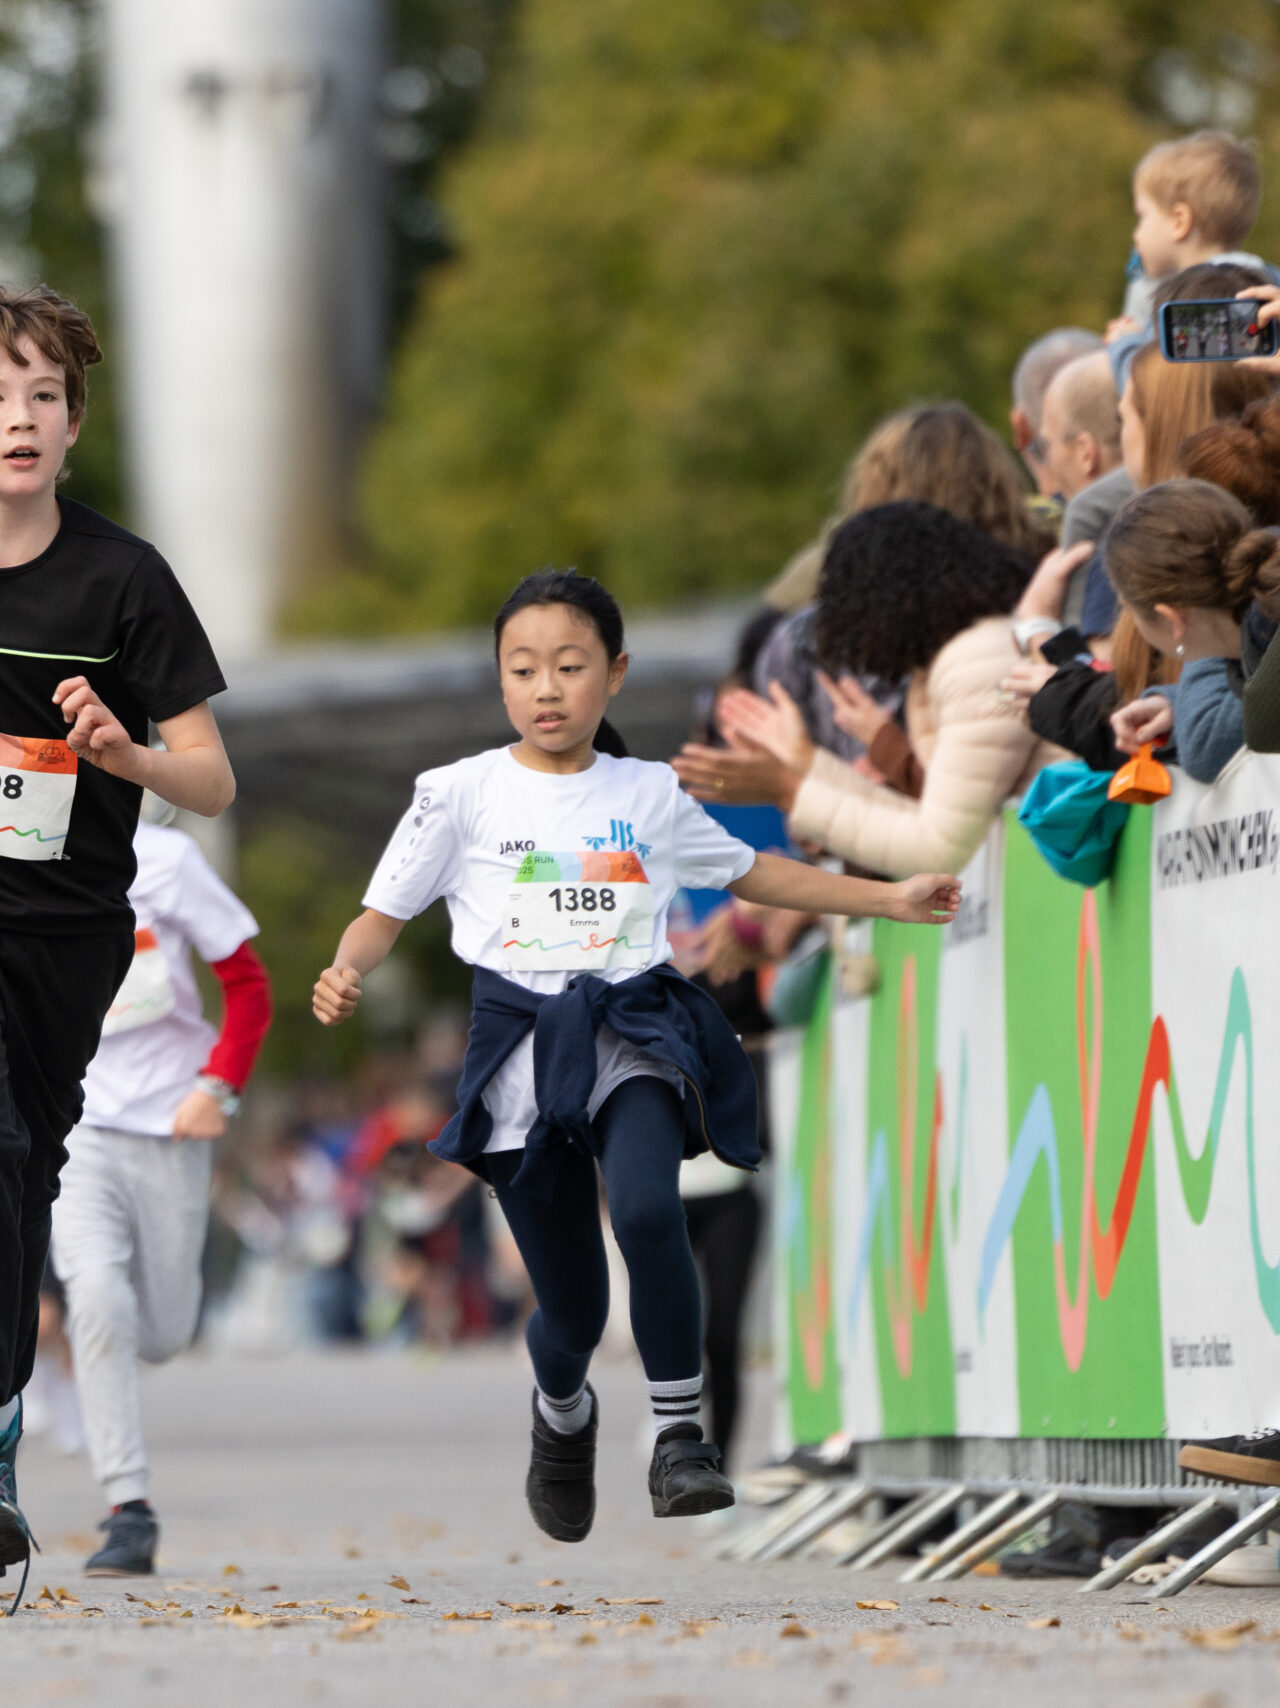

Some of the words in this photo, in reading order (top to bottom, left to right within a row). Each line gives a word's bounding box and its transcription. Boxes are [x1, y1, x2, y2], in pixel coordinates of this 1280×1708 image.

[499, 839, 536, 855] JAKO
[534, 856, 554, 865] RUN
[548, 888, 616, 912] 1388
[511, 917, 520, 928] B
[570, 919, 600, 927] Emma
